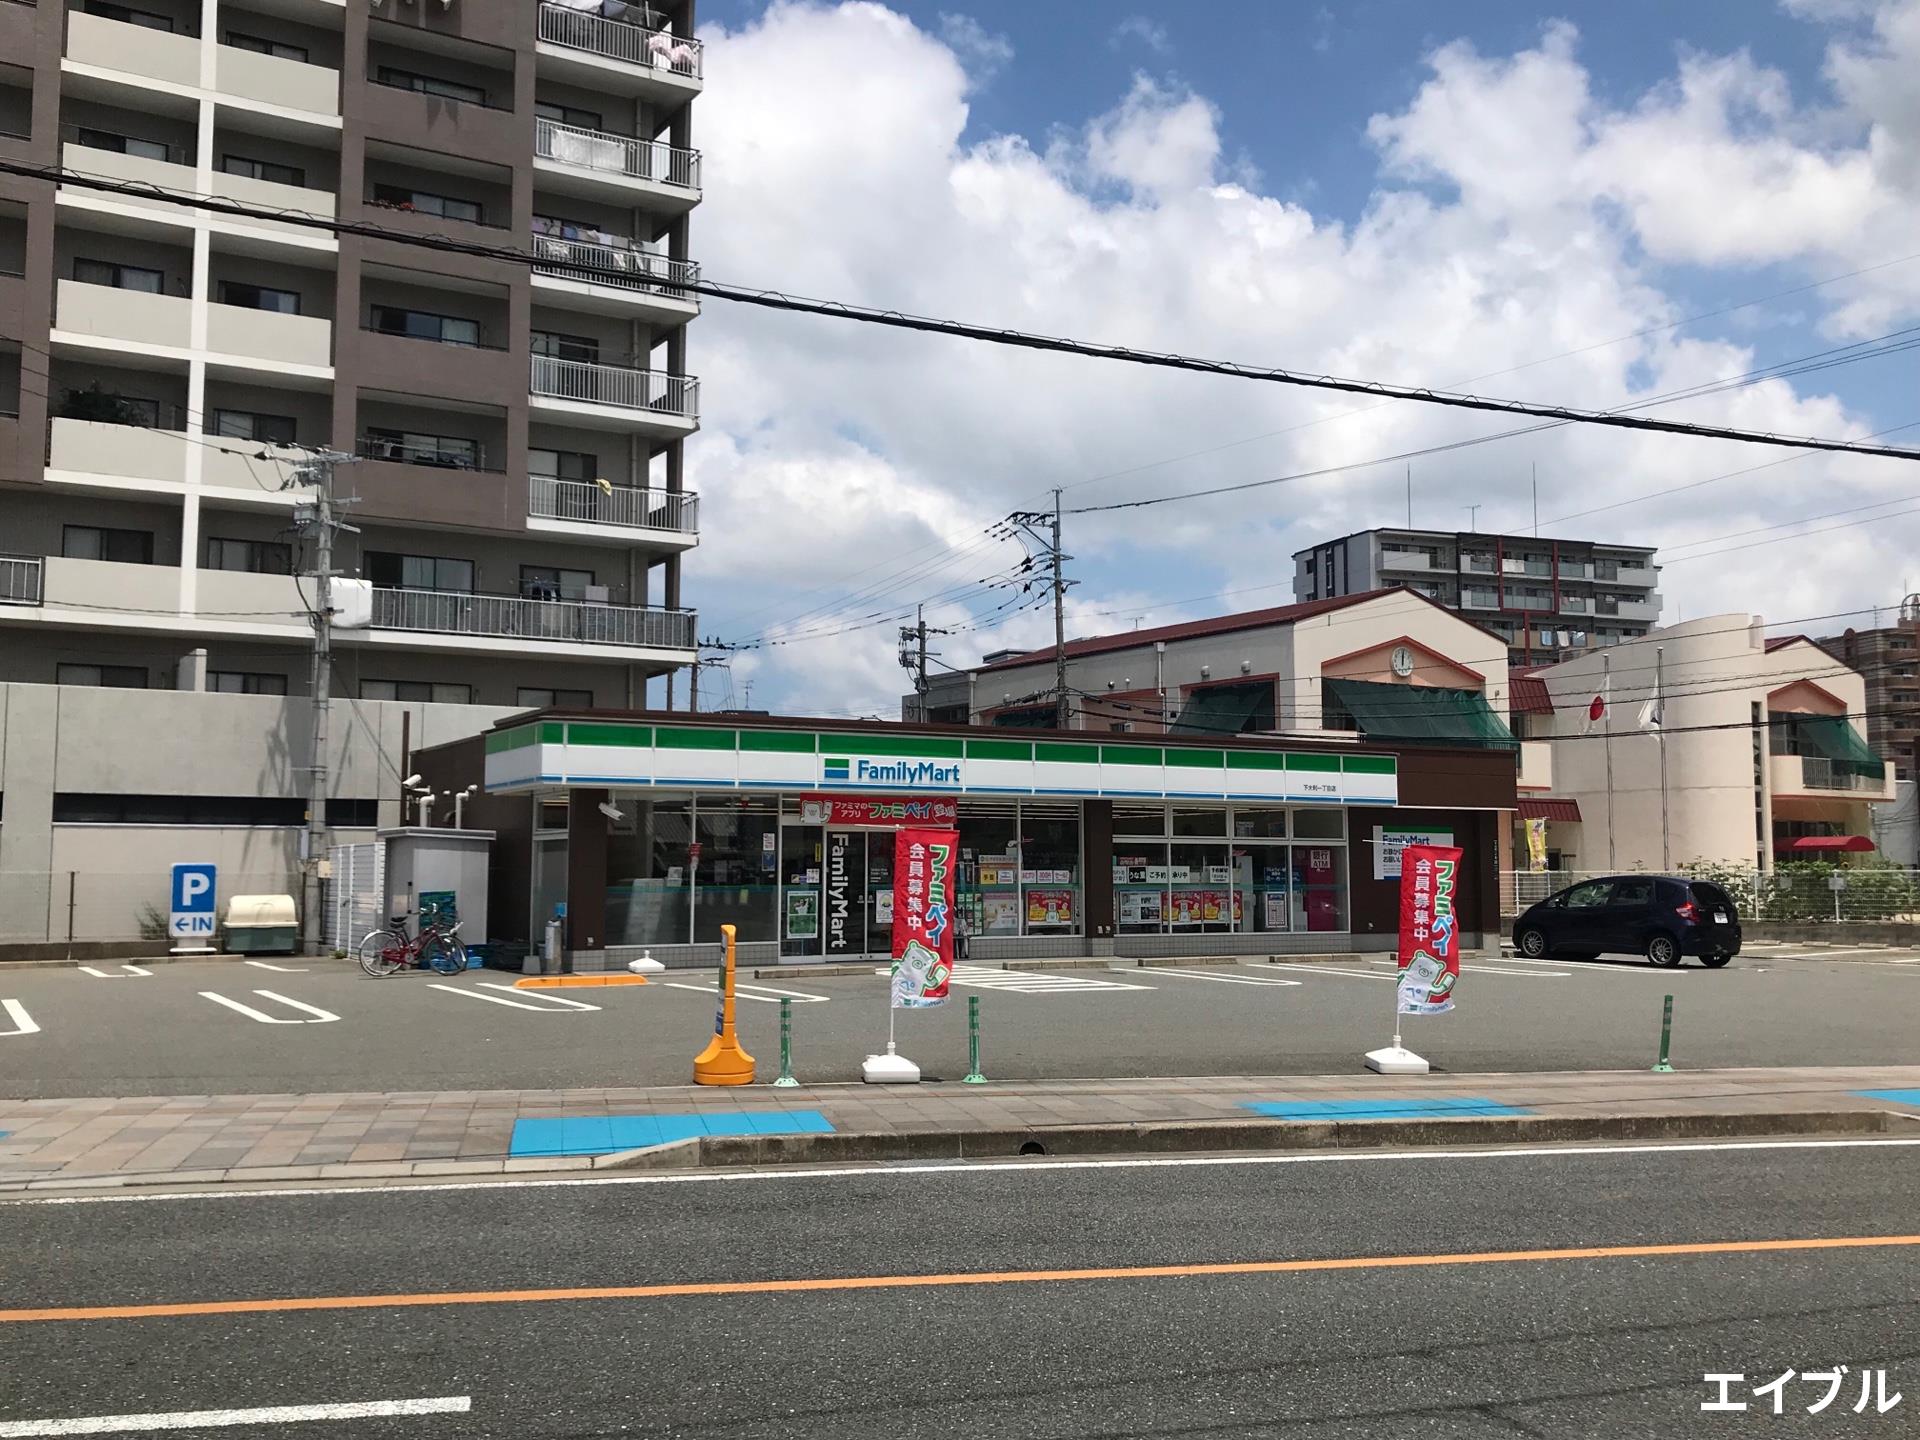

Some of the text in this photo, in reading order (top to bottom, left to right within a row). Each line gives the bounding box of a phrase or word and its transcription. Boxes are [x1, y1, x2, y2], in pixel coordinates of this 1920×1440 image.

[857, 759, 960, 783] FamilyMart
[834, 801, 867, 811] ファミマの
[841, 809, 861, 818] アプリ
[868, 801, 933, 819] ファミペイ
[1382, 835, 1430, 847] FamilyMart
[1312, 860, 1329, 868] ATM
[182, 872, 210, 906] P
[828, 834, 849, 948] FamilyMart
[907, 842, 925, 931] 会員募集中
[925, 844, 950, 947] ファミペイ
[1413, 858, 1431, 942] 会員募集中
[1431, 860, 1455, 956] ファミペイ
[192, 917, 212, 931] IN
